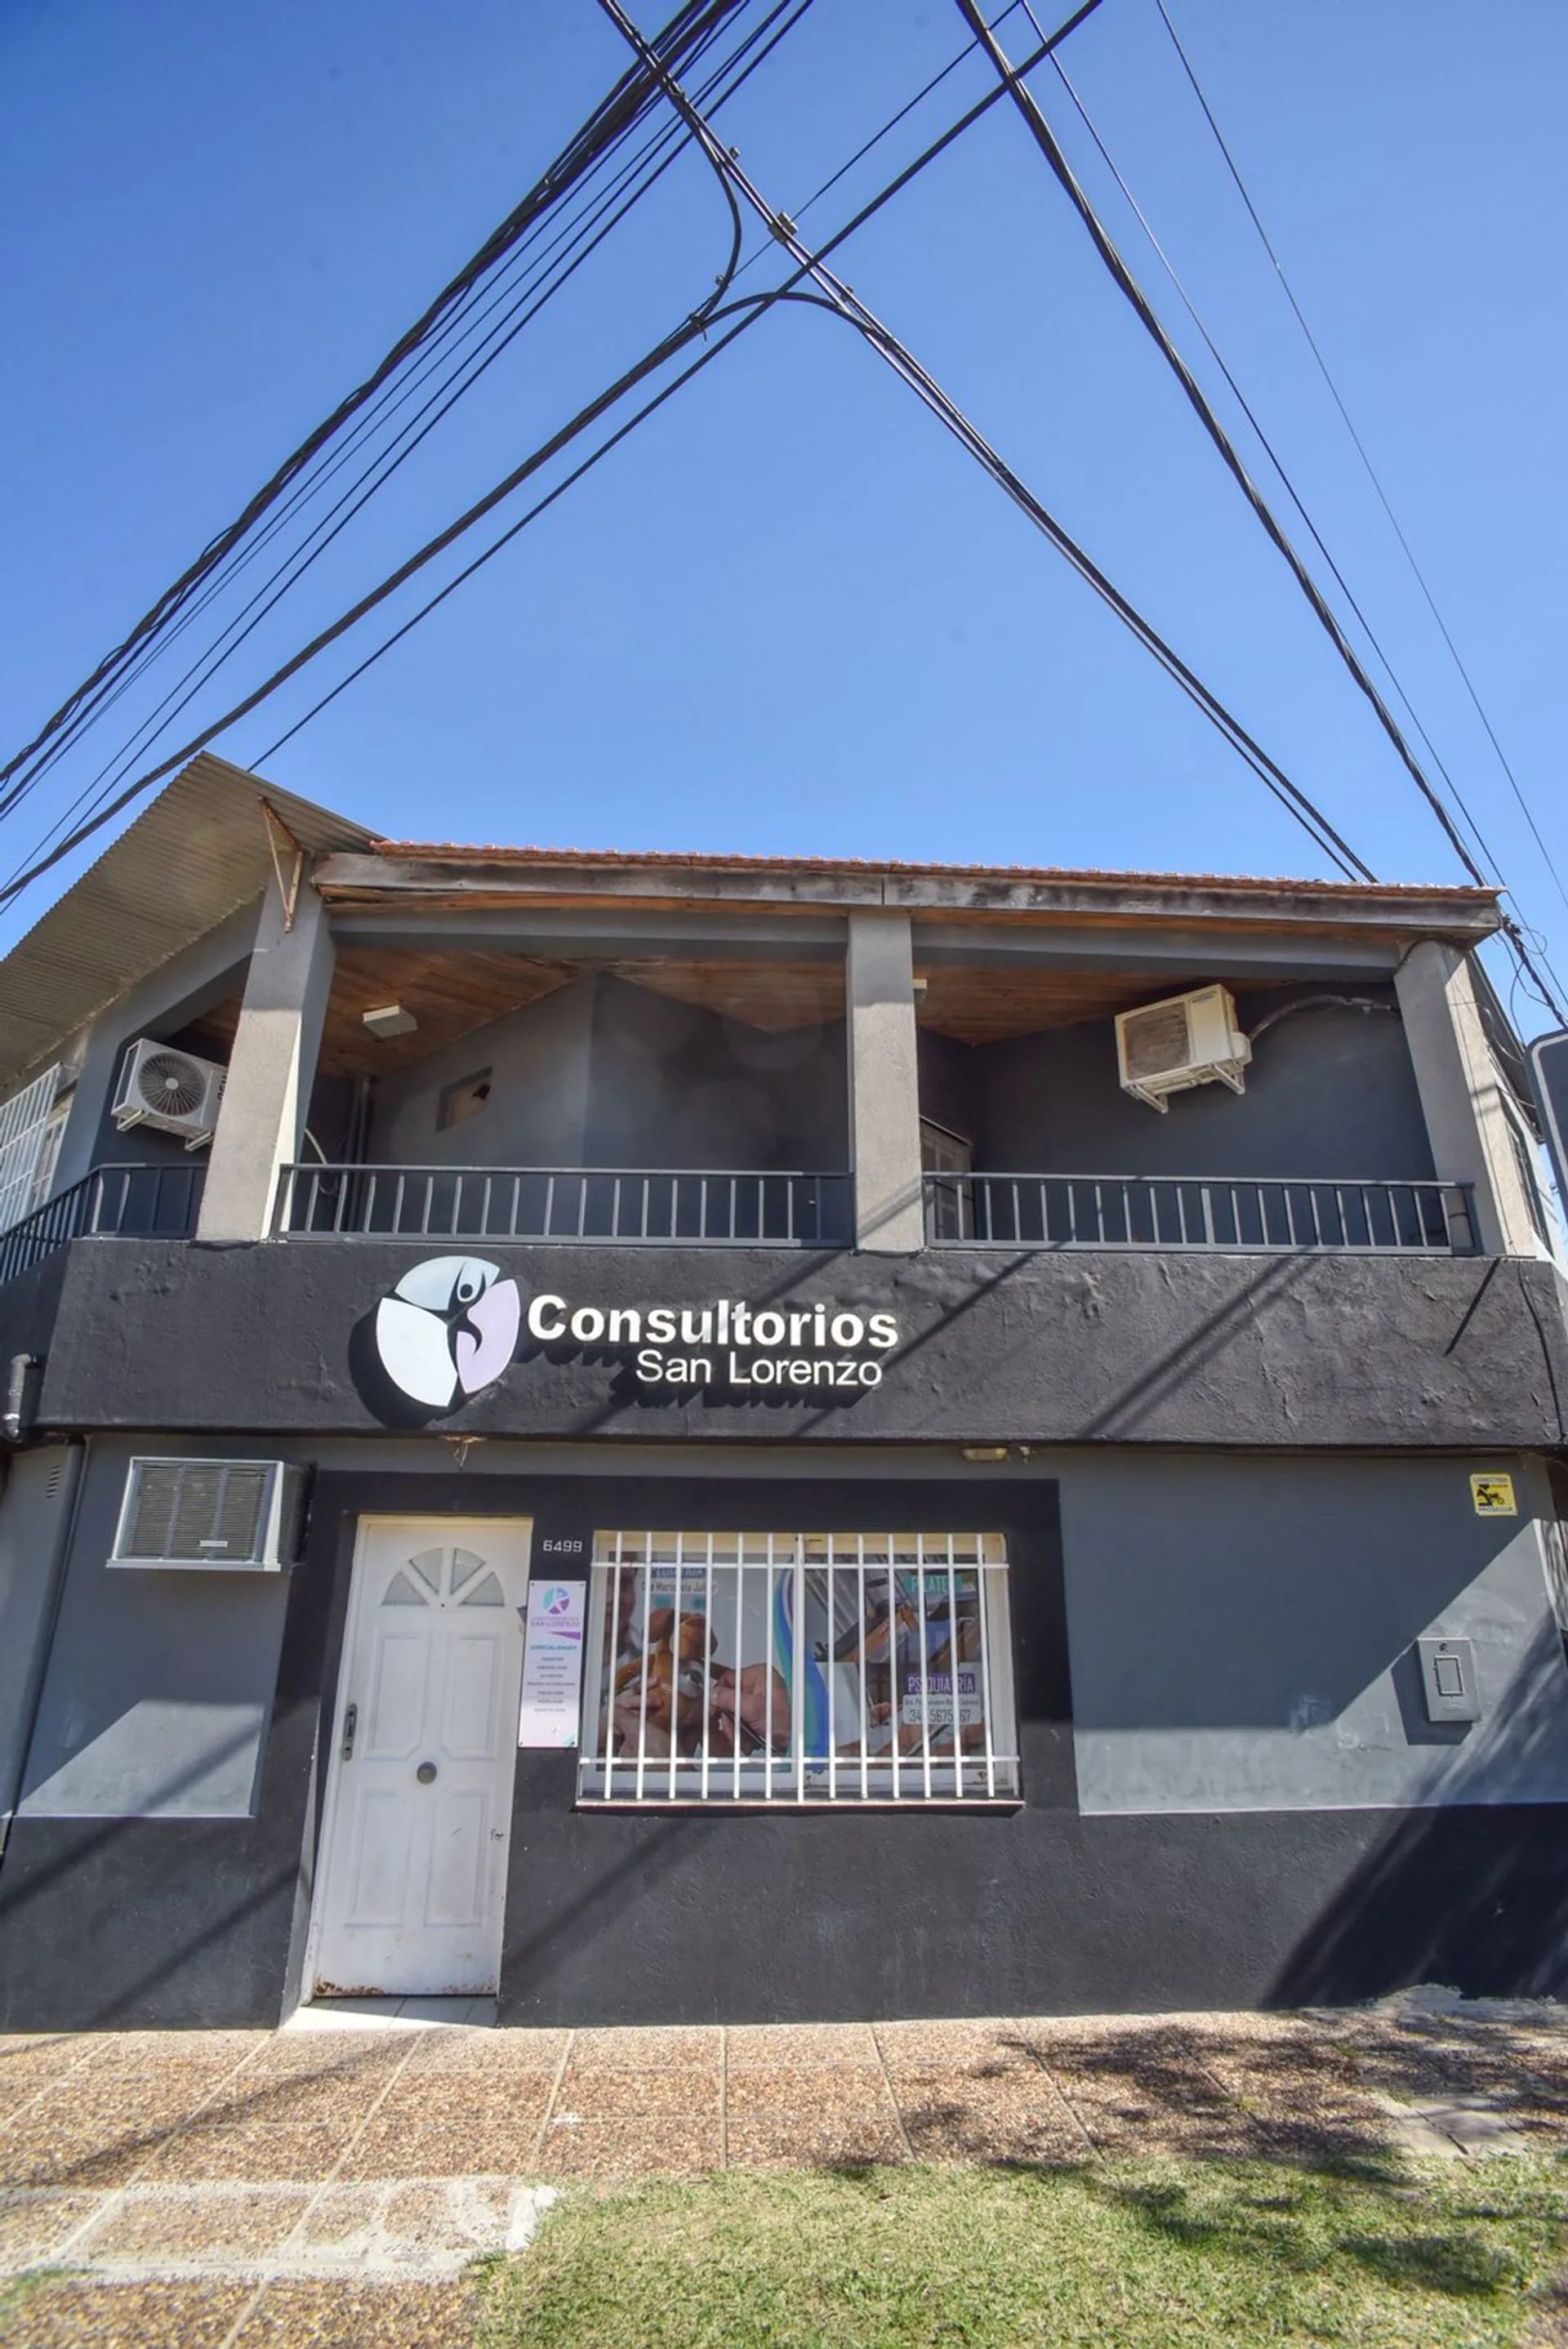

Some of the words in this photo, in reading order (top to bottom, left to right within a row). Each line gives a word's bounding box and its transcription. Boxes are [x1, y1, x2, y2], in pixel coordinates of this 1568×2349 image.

[528, 1295, 898, 1348] Consultorios
[636, 1349, 711, 1383] San
[728, 1351, 882, 1386] Lorenzo
[542, 1540, 583, 1553] 6499
